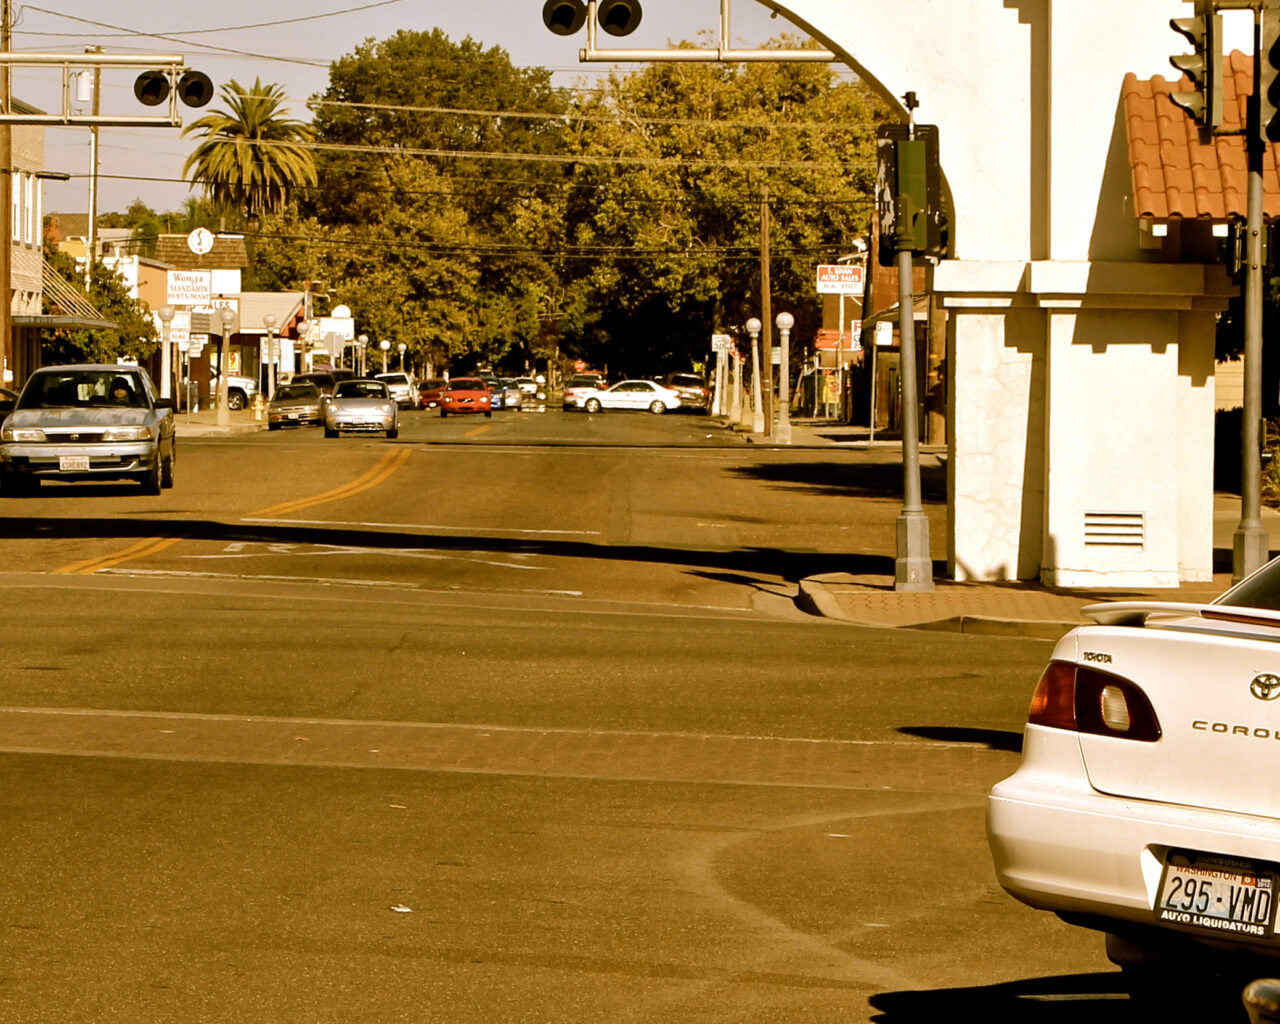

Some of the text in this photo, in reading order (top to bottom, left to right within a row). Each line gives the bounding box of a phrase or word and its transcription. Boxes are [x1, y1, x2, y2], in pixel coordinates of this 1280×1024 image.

[169, 285, 208, 293] MANDARIN
[1083, 652, 1113, 664] TOYOTA
[1196, 856, 1252, 870] CONSUMER
[1176, 865, 1237, 881] WASHINGTON
[1161, 910, 1265, 936] AUTO LIQUIDATORS
